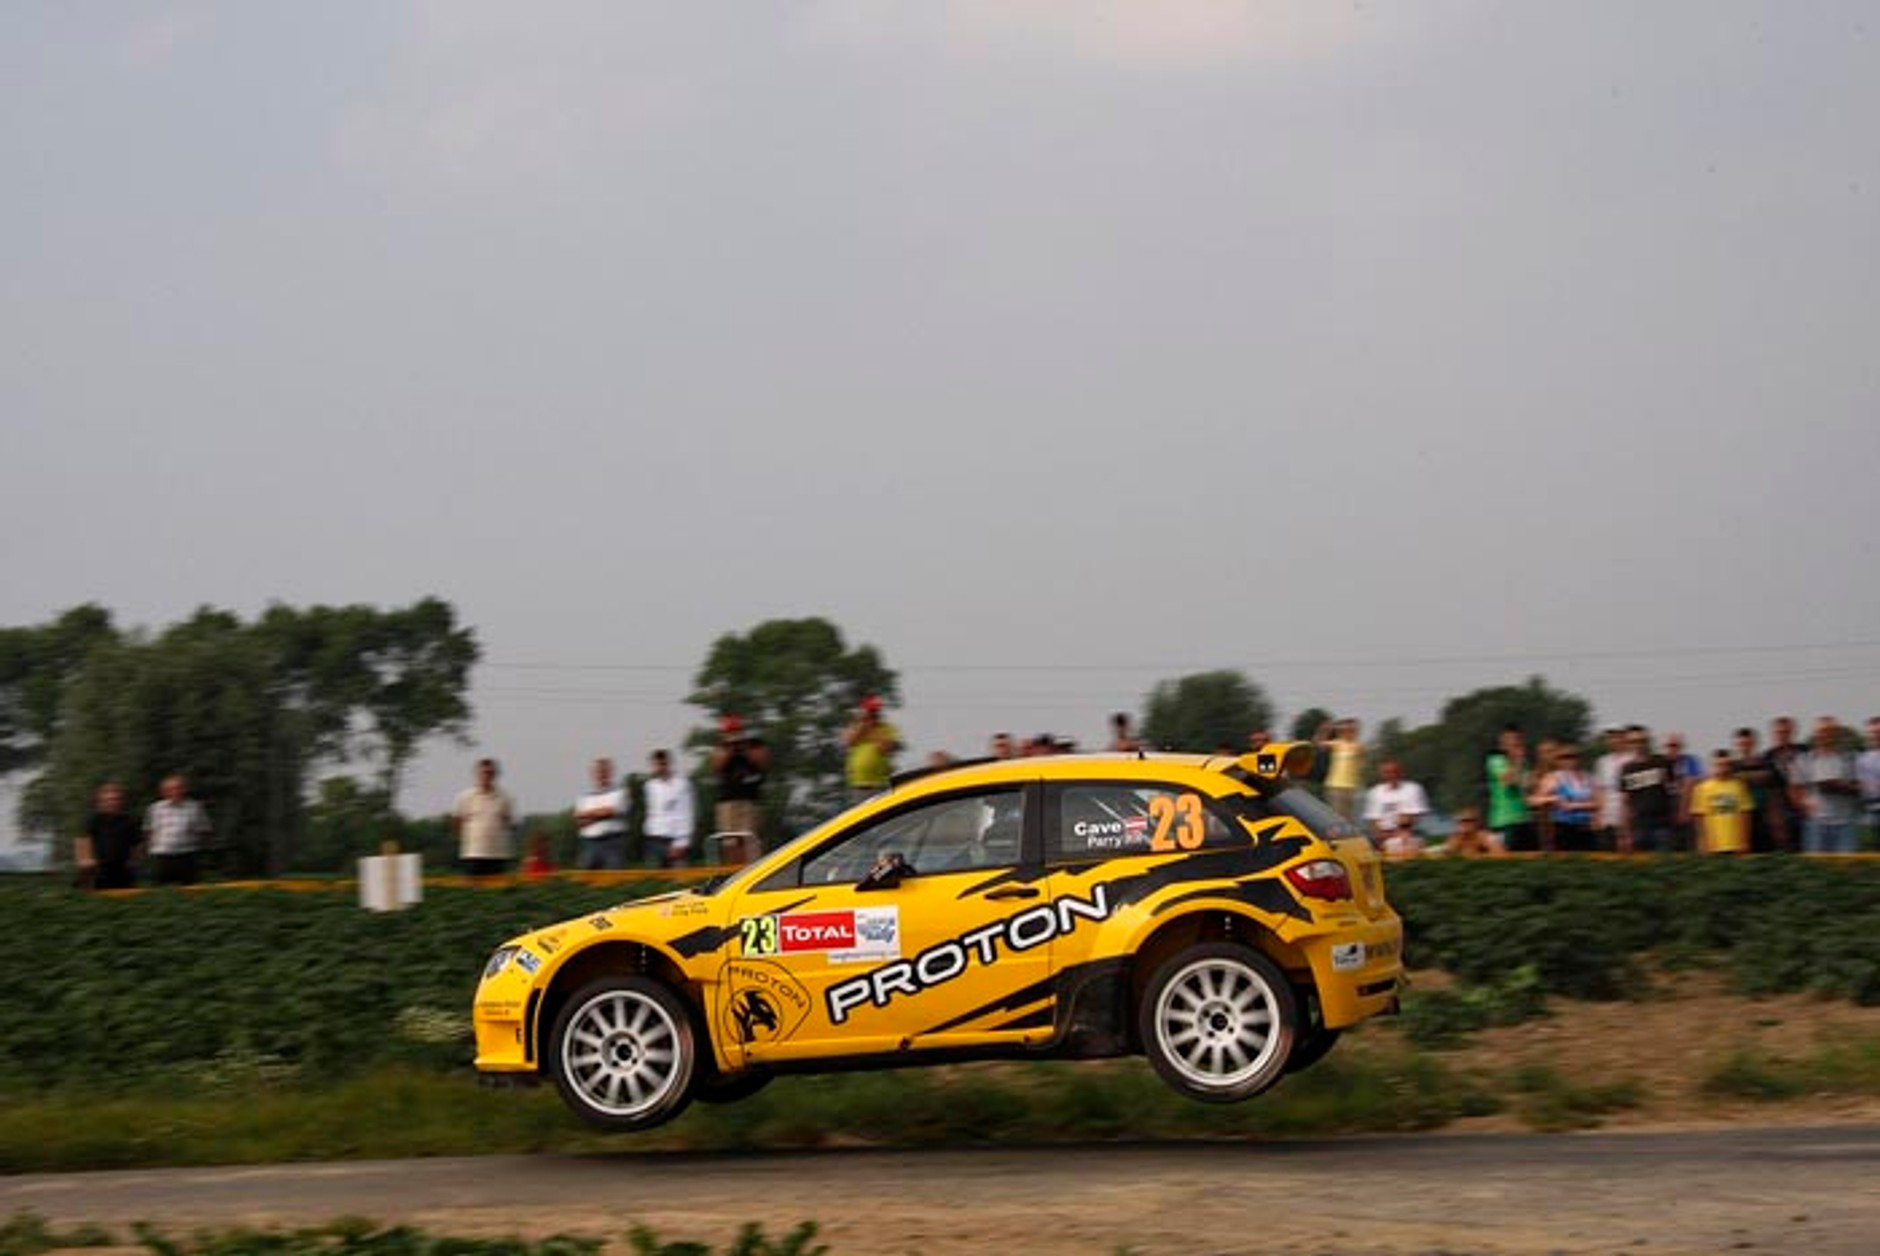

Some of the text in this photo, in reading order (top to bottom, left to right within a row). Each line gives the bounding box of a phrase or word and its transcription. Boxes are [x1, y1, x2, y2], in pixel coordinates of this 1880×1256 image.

[1074, 821, 1121, 836] Cave
[1148, 793, 1204, 851] 23
[741, 917, 776, 955] 23
[827, 884, 1110, 1023] PROTON
[728, 966, 806, 1008] PROTON
